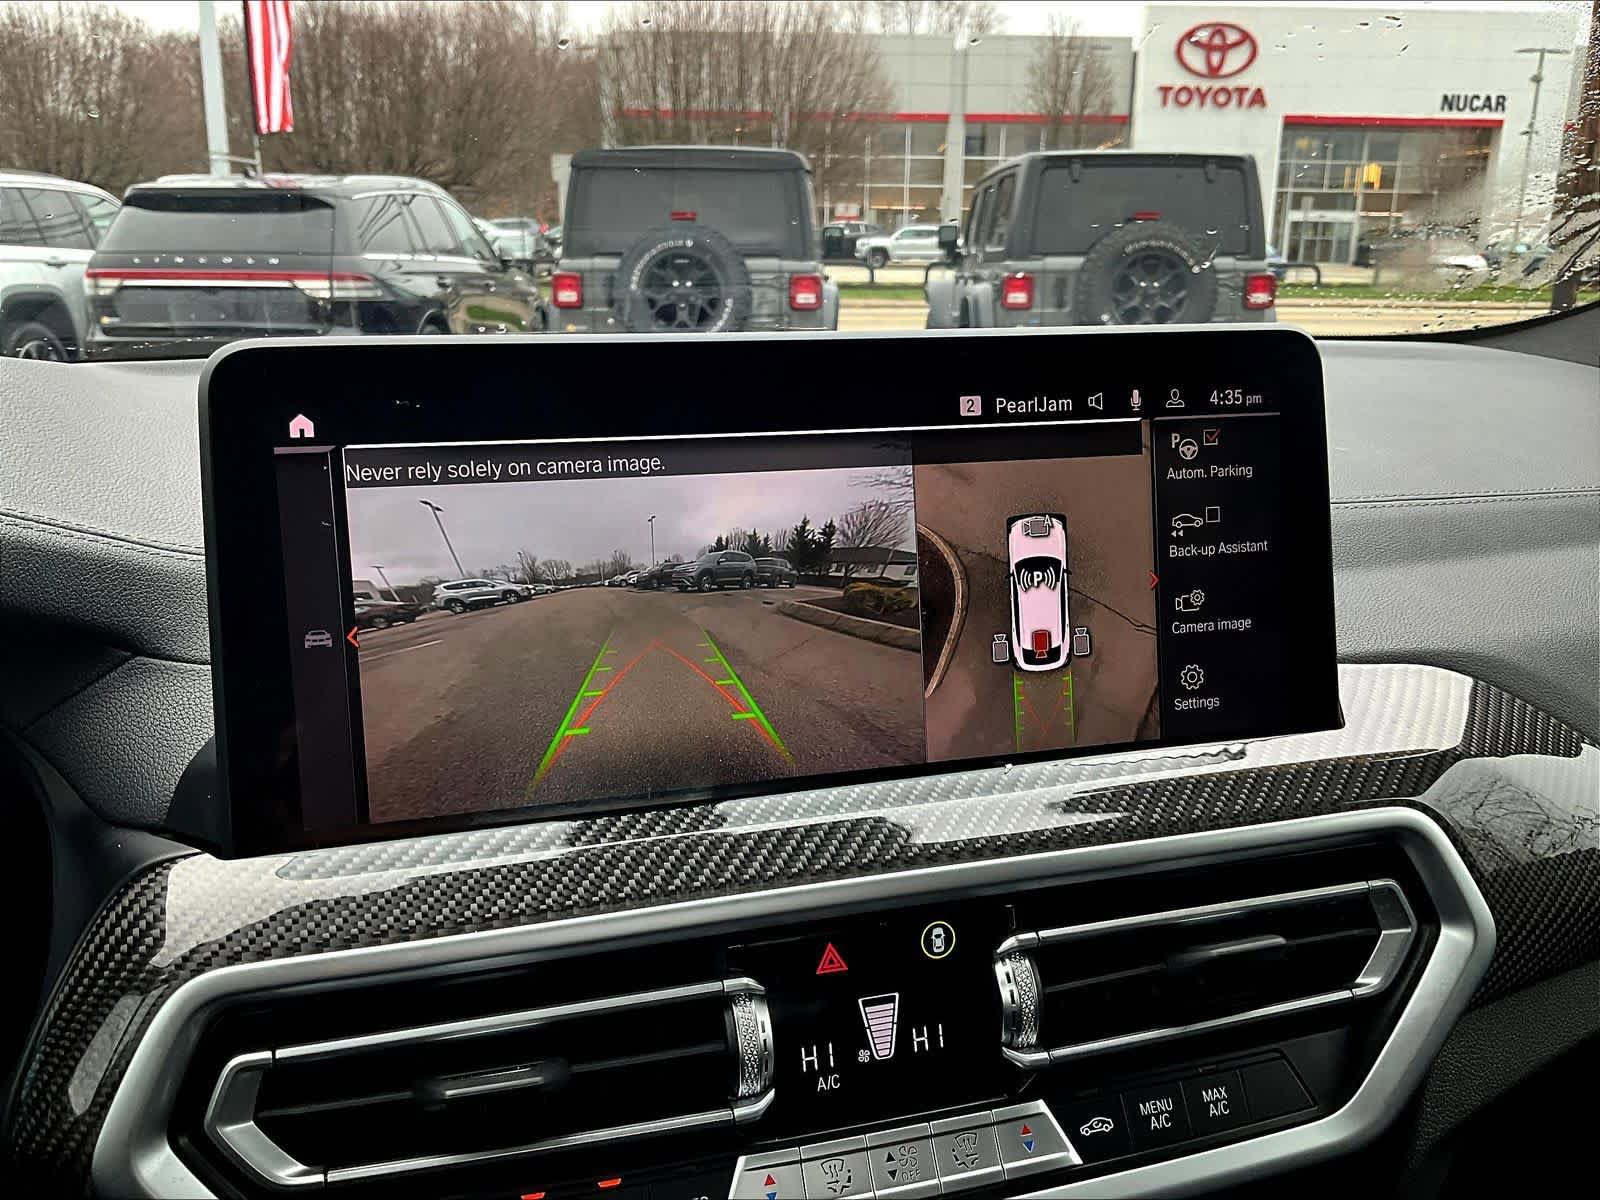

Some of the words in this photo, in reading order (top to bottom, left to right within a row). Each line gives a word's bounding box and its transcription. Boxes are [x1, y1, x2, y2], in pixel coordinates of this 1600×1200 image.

[1157, 86, 1267, 108] TOYOTA
[1440, 94, 1506, 112] NUCAR
[996, 397, 1073, 414] PearlJam
[1209, 389, 1242, 405] 4:35
[1246, 394, 1262, 406] pm
[346, 463, 402, 482] Never
[408, 461, 442, 482] rely
[447, 459, 502, 481] solely
[508, 461, 531, 476] on
[536, 459, 603, 475] camera
[607, 456, 666, 475] image.
[1167, 467, 1208, 480] Autom.
[1210, 464, 1253, 478] Parking
[1169, 543, 1216, 557] Back-up
[1218, 540, 1268, 554] Assistant
[1171, 621, 1215, 634] Camera
[1217, 618, 1252, 631] image
[1174, 696, 1220, 711] Settings
[817, 1074, 841, 1092] A/C
[1201, 1086, 1228, 1103] MAX
[1139, 1097, 1173, 1116] MENU
[1209, 1100, 1230, 1117] A/C
[1150, 1113, 1172, 1130] A/C
[901, 1169, 921, 1182] OFF
